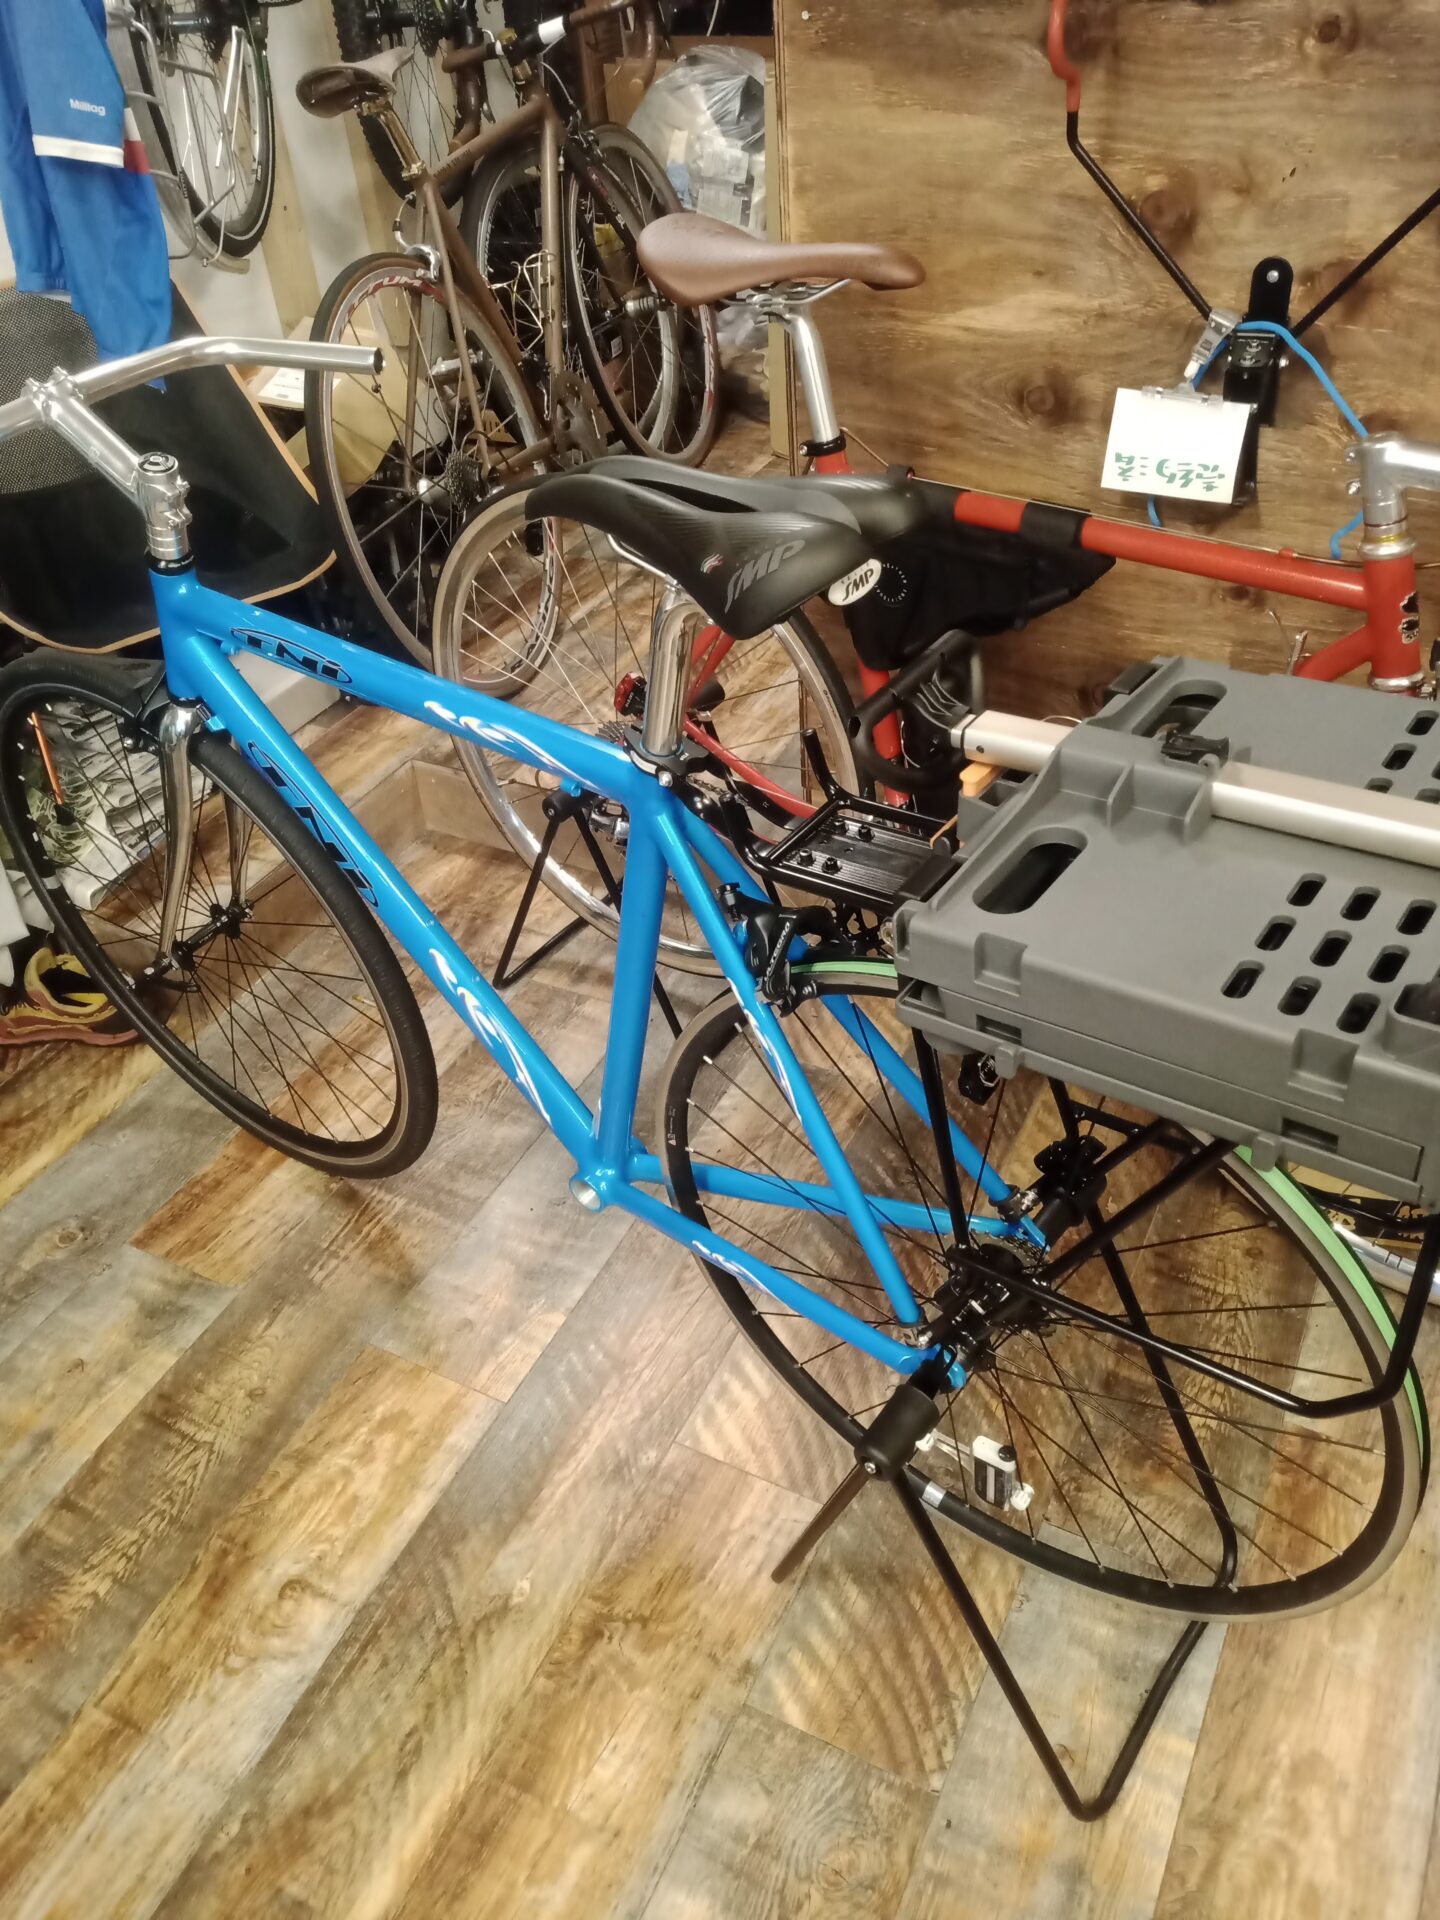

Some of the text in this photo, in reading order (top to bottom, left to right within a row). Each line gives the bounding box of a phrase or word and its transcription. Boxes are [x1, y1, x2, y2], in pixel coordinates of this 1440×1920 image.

[1114, 451, 1226, 492] 売約済
[724, 539, 806, 615] SMP
[842, 567, 875, 602] SMP
